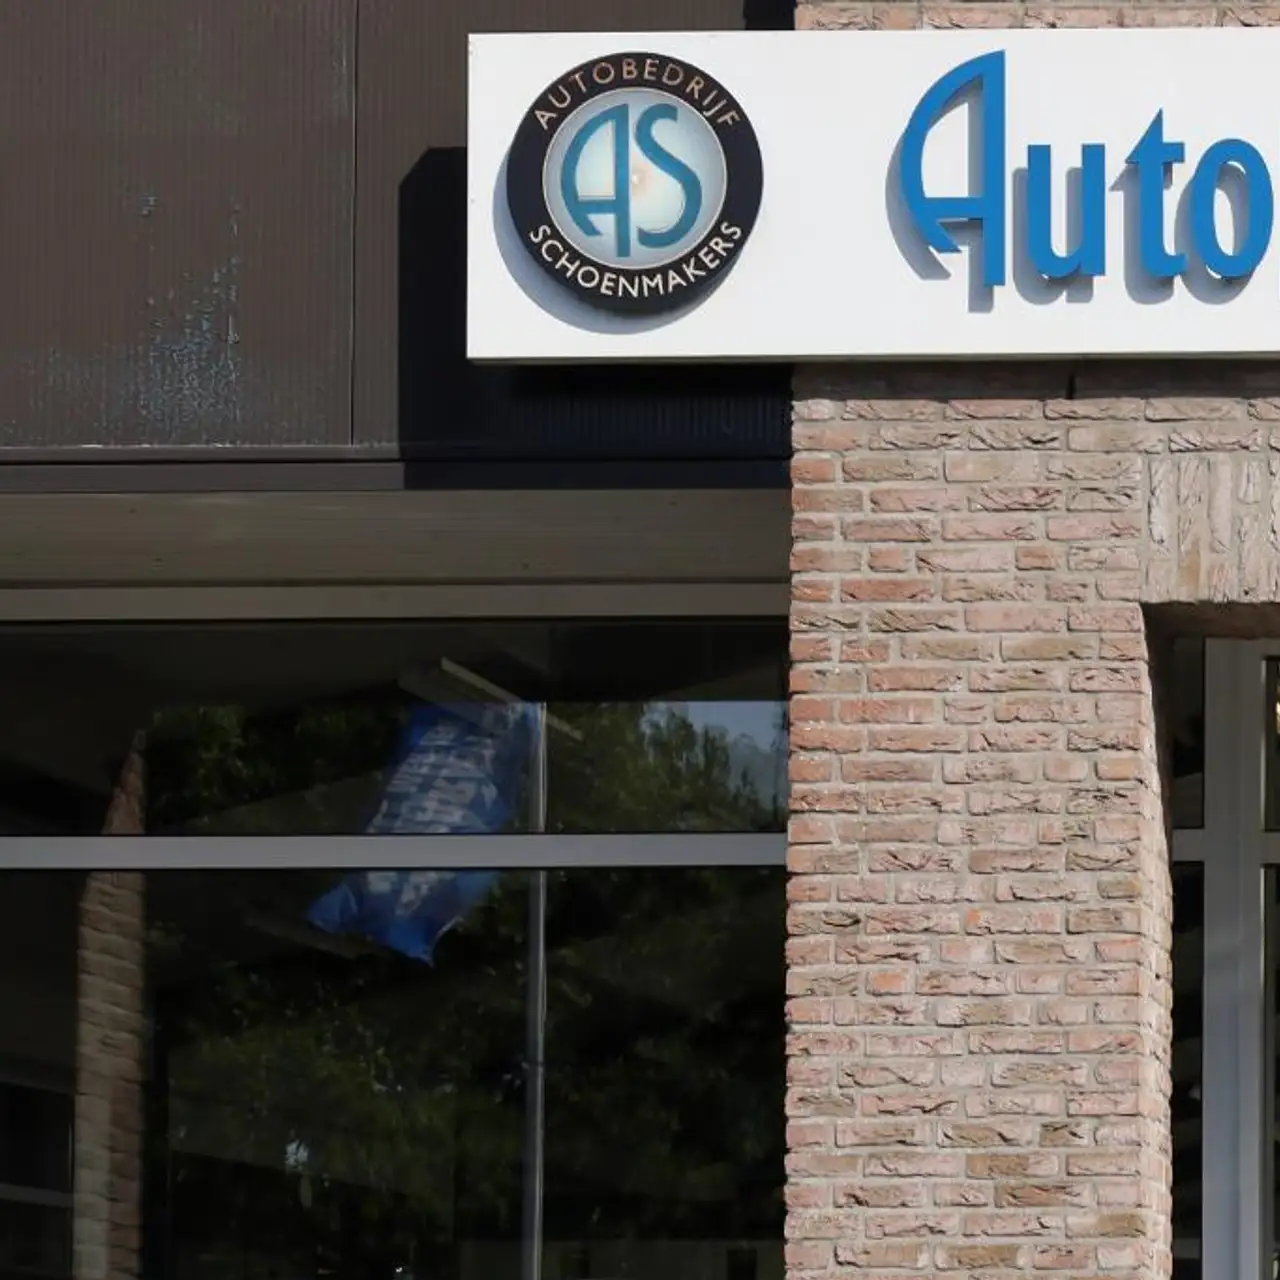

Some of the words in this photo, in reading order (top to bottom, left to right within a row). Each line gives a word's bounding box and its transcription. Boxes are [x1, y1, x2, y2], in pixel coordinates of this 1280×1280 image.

[534, 58, 741, 131] AUTOBEDRIJF
[561, 102, 703, 257] AS
[529, 219, 742, 298] SCHOENMAKERS
